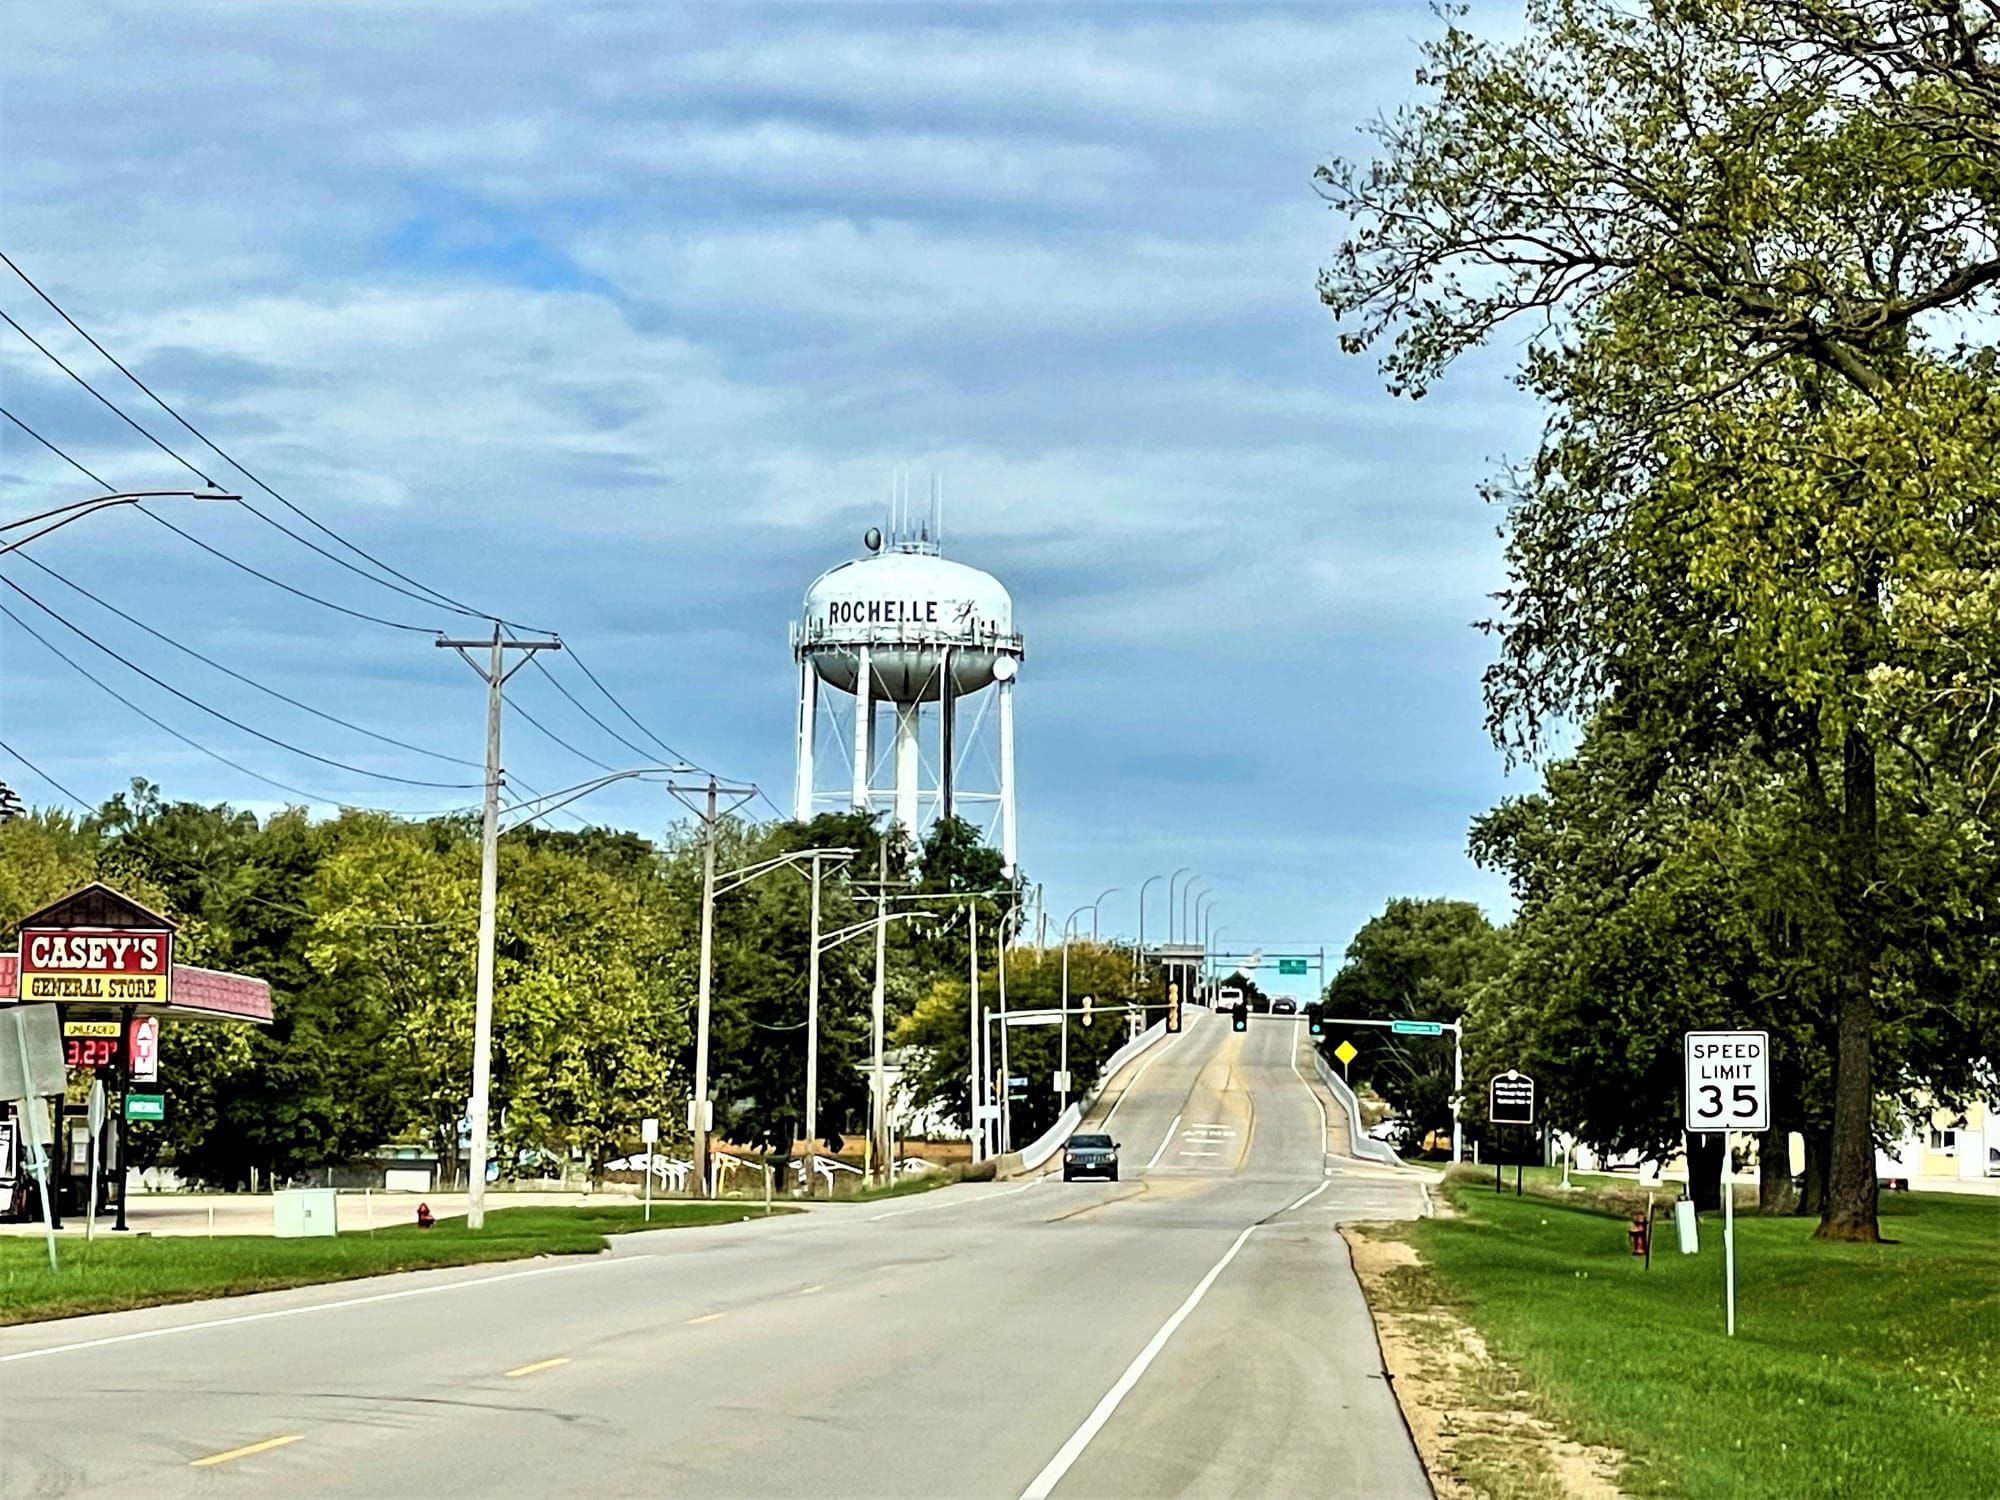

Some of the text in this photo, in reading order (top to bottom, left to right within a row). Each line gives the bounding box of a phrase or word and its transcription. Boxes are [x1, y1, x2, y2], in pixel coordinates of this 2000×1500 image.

[829, 600, 938, 624] ROCHELLE
[31, 936, 158, 970] CASEY'S
[31, 977, 157, 998] GENERAL STORE
[68, 1025, 116, 1034] UNLEADED
[136, 1022, 153, 1073] ATM
[1694, 1044, 1760, 1058] SPEED
[1702, 1065, 1752, 1080] LIMIT
[1697, 1085, 1759, 1118] 35
